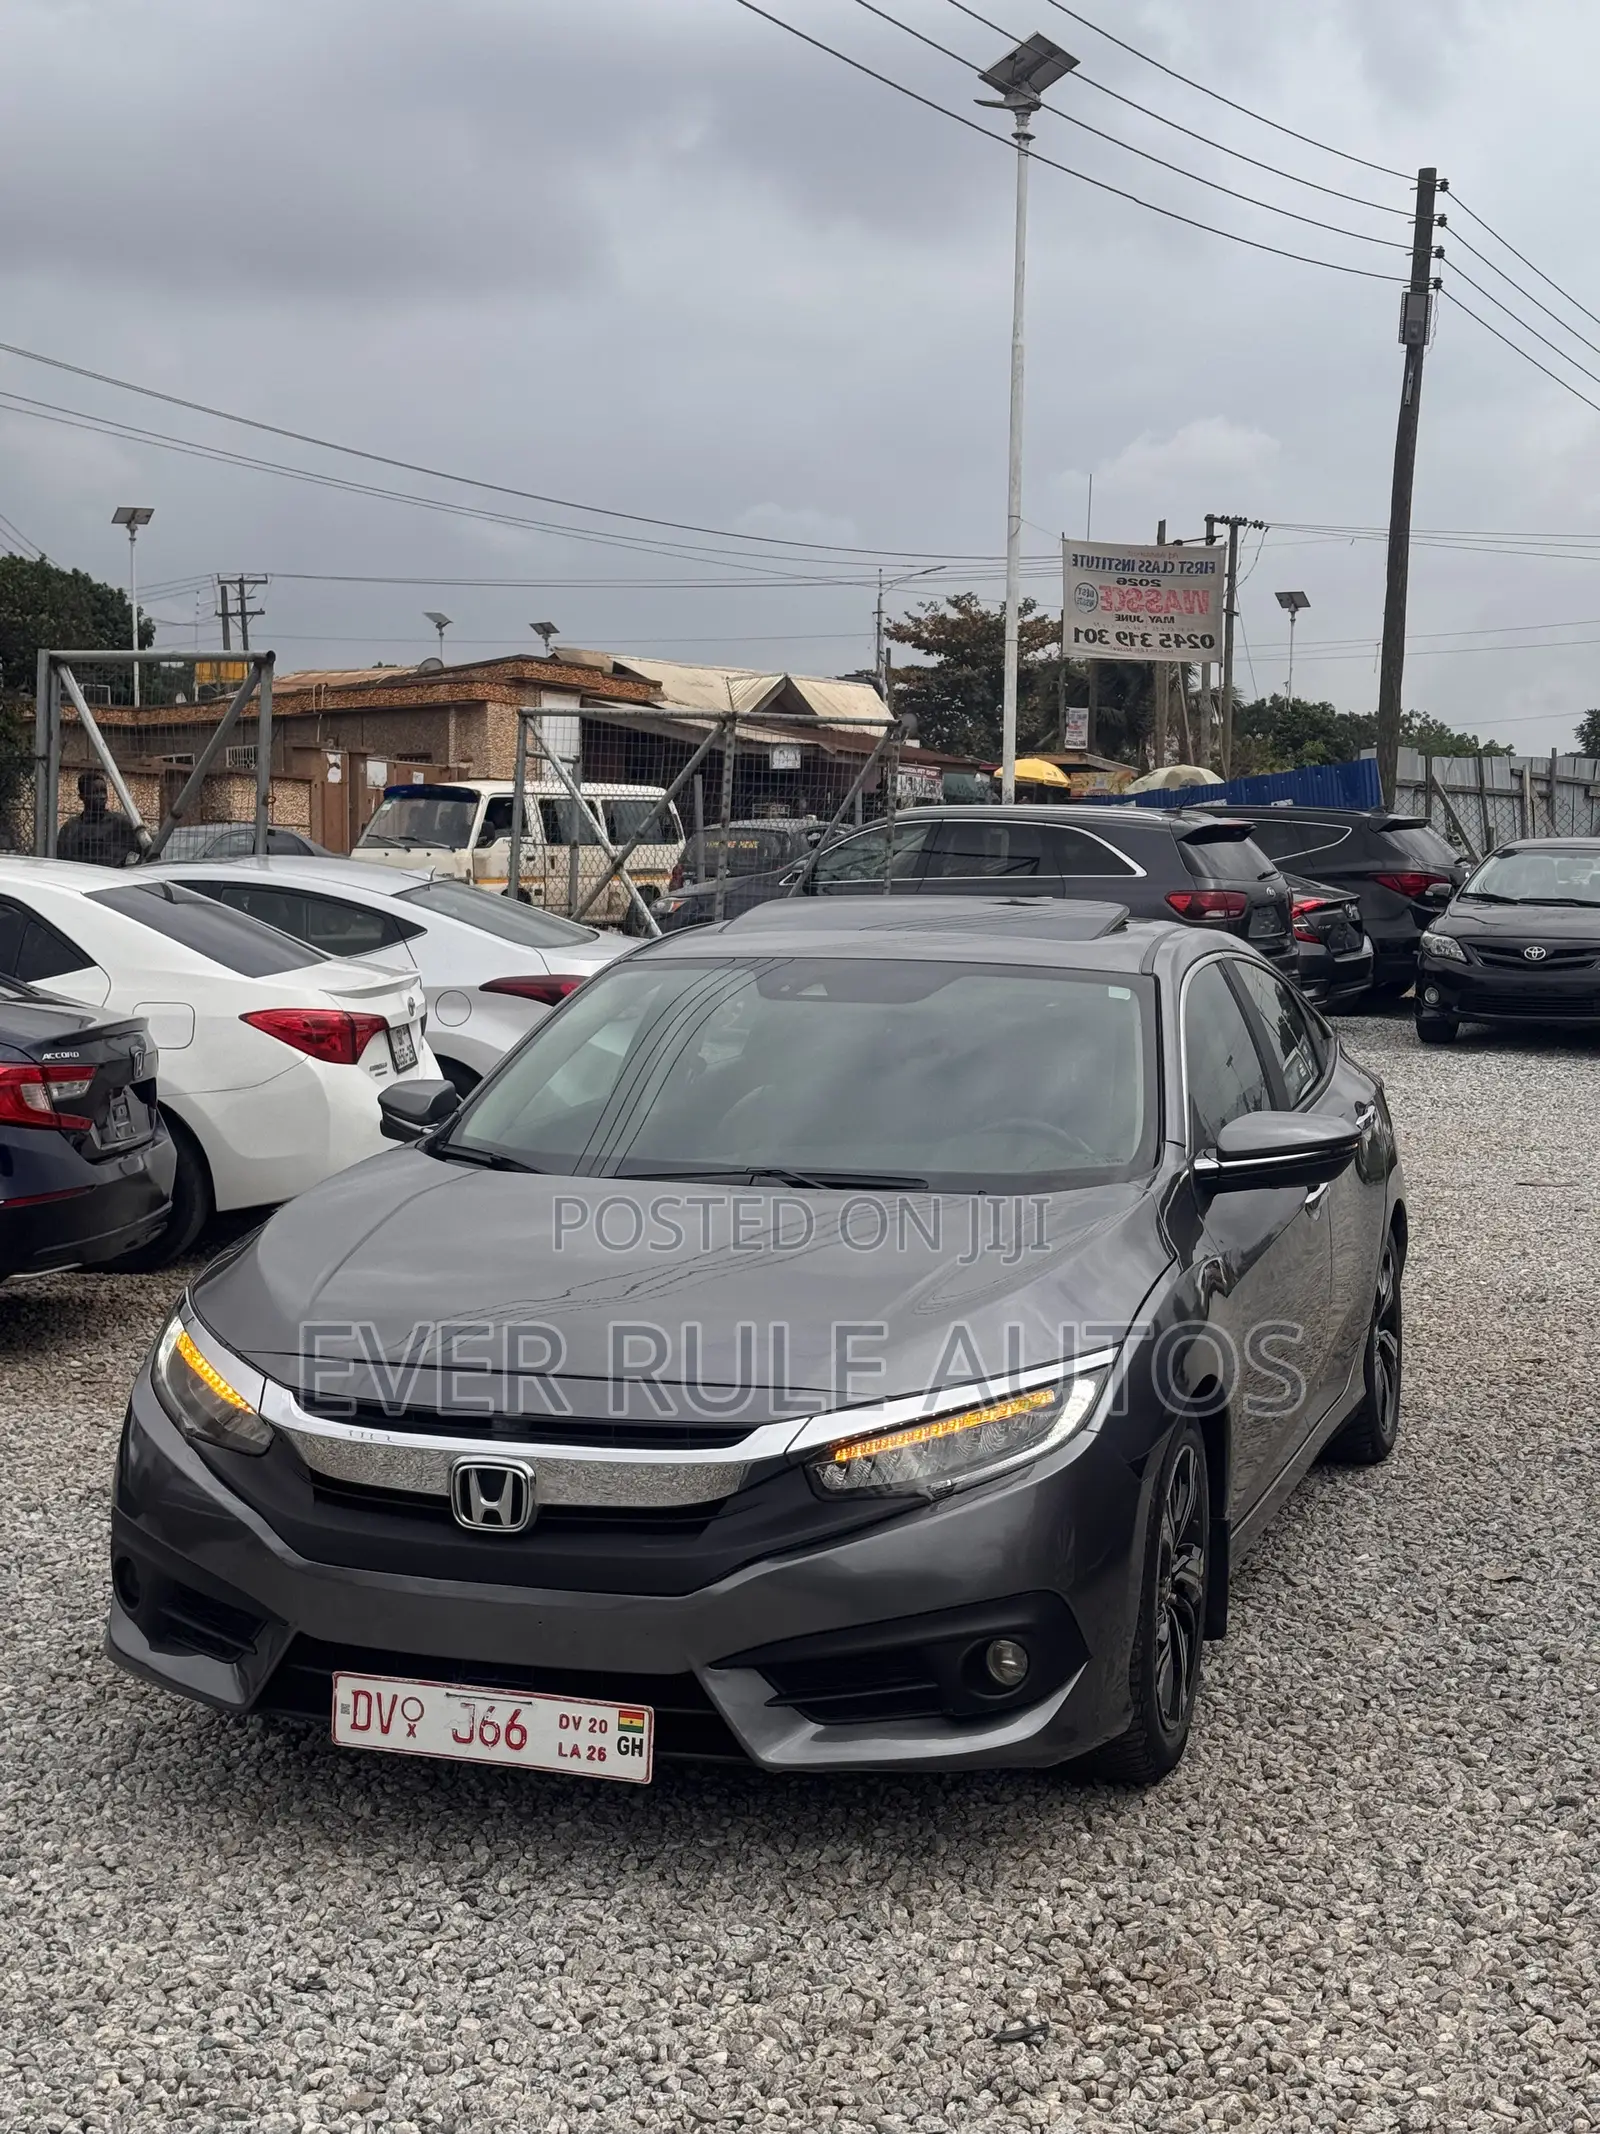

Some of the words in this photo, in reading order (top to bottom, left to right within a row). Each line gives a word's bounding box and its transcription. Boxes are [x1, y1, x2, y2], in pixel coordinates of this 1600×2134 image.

[42, 1051, 80, 1060] ACCORD
[351, 1689, 398, 1735] DV
[558, 1713, 583, 1731] DV
[588, 1717, 609, 1734] 20
[558, 1742, 582, 1759] LA
[586, 1745, 607, 1762] 26
[616, 1736, 644, 1758] GH
